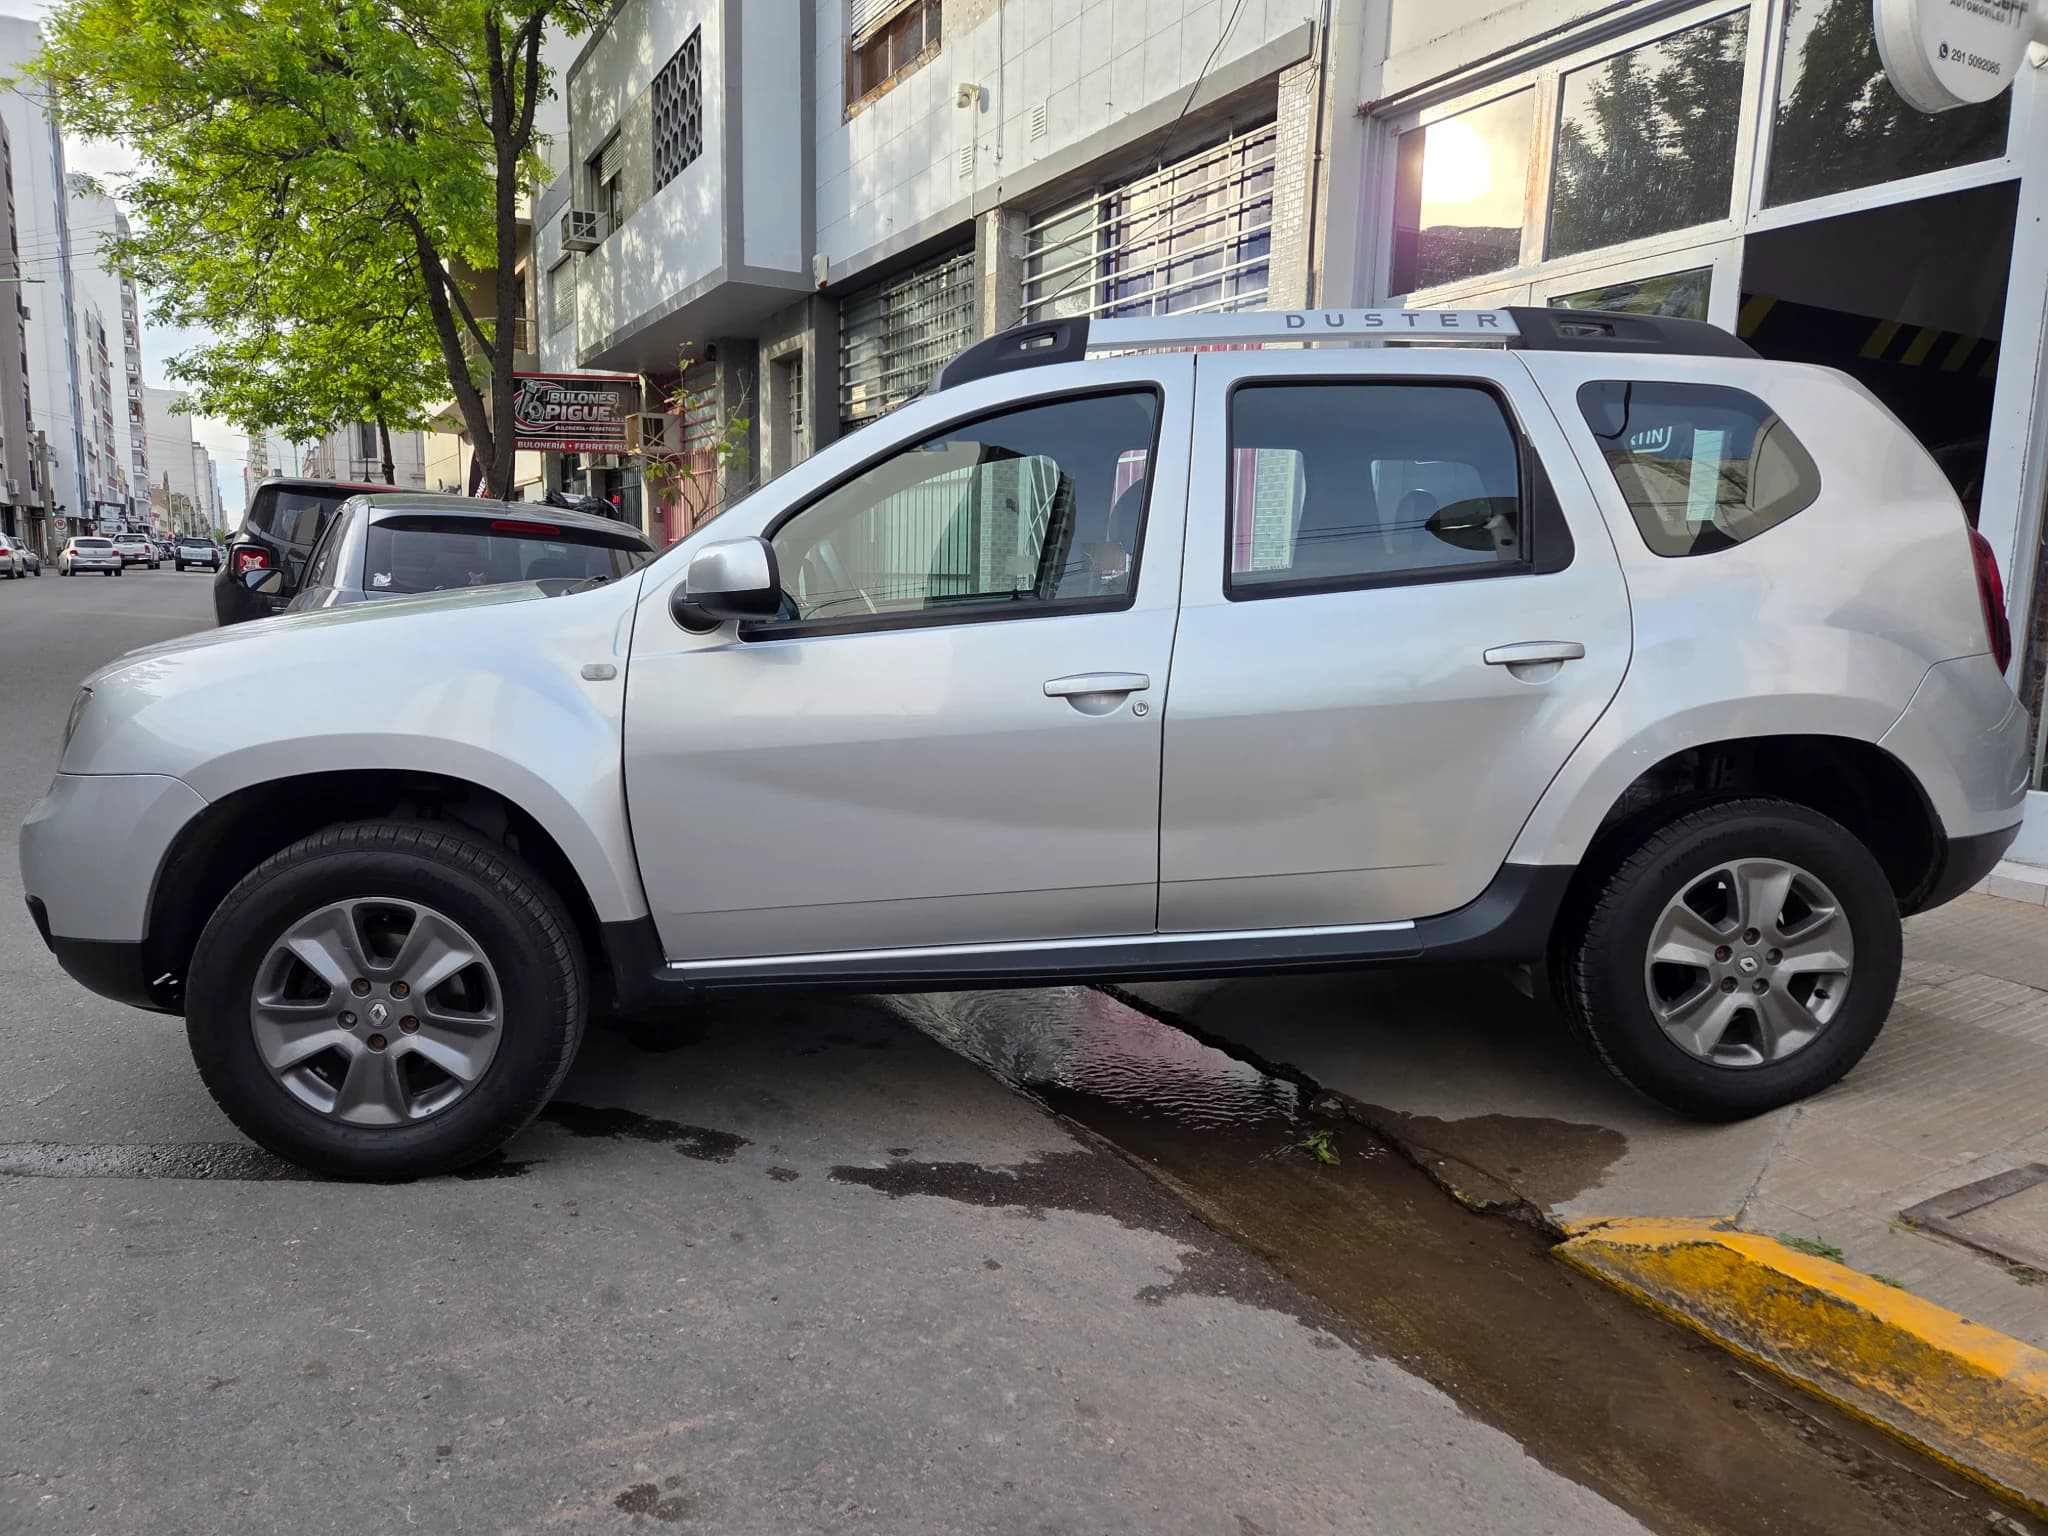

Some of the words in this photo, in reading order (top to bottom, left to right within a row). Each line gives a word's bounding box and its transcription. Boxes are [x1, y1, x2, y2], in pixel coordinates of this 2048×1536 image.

[1951, 48, 1965, 64] 291
[1285, 313, 1499, 329] DUSTER
[549, 392, 617, 405] BULONES
[544, 404, 612, 421] PIGUE
[517, 440, 566, 450] BULONERÍA
